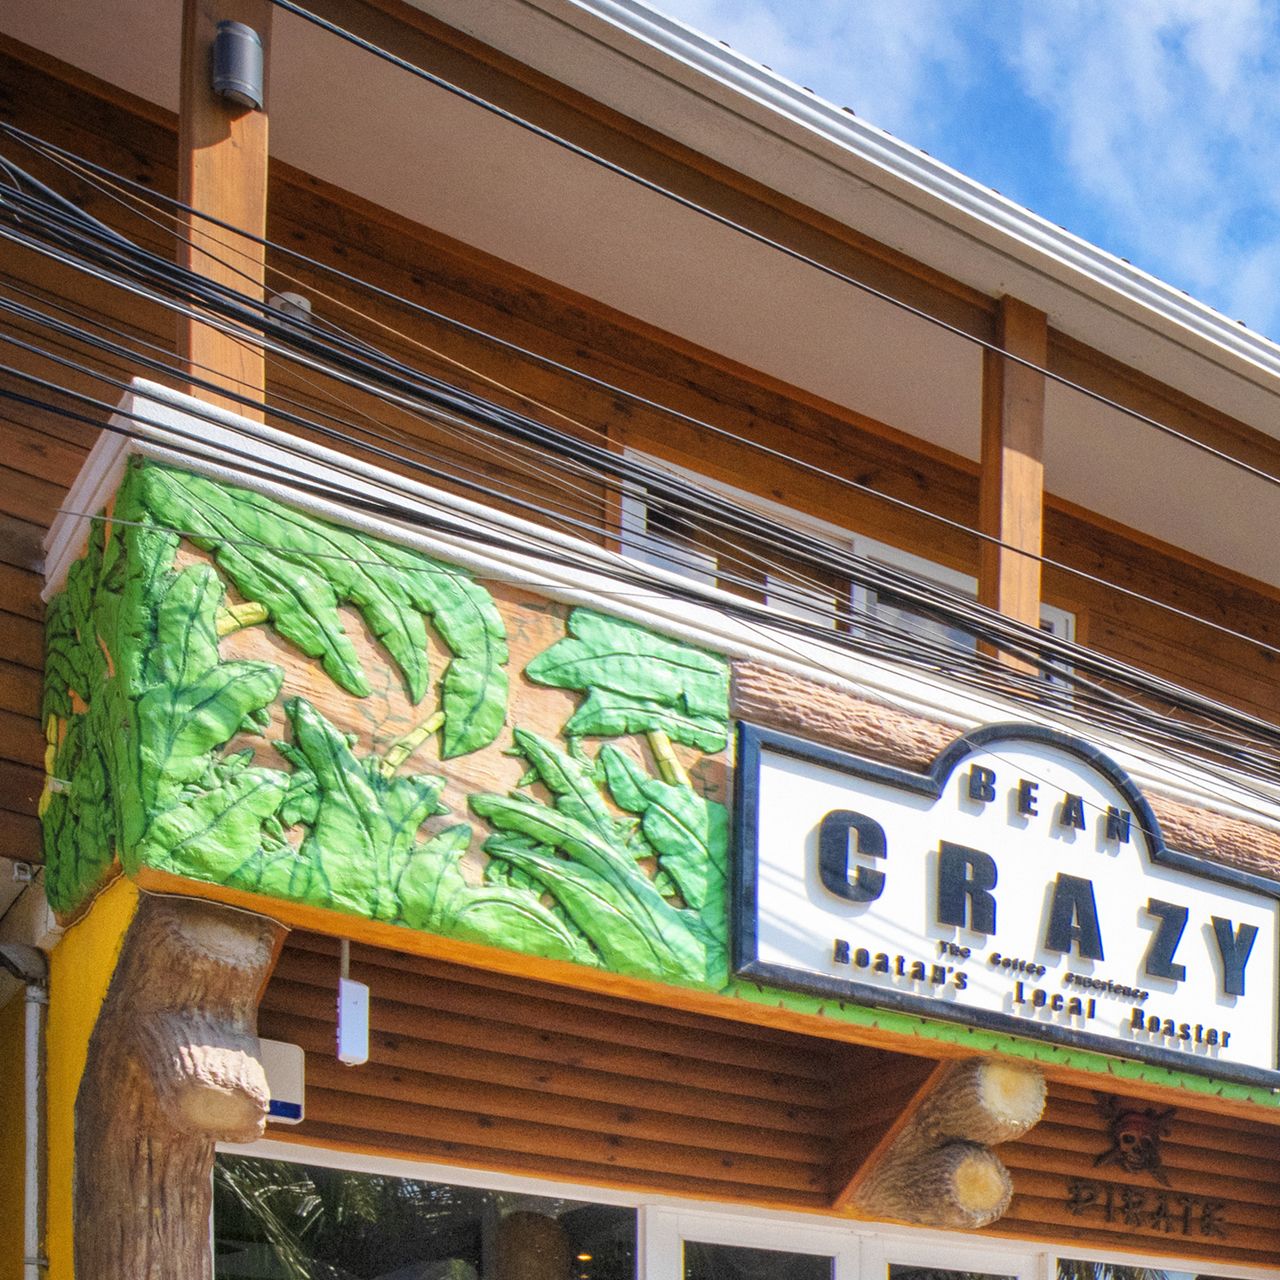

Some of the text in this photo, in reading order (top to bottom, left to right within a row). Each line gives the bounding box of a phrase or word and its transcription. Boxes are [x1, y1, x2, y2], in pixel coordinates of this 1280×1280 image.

[968, 763, 1132, 844] BEAN
[817, 809, 1259, 997] CRAZY
[833, 938, 1231, 1049] Roatan's Local Roaster
[938, 940, 972, 960] The
[989, 950, 1047, 976] Coffee
[1066, 1181, 1227, 1237] PIRATE
